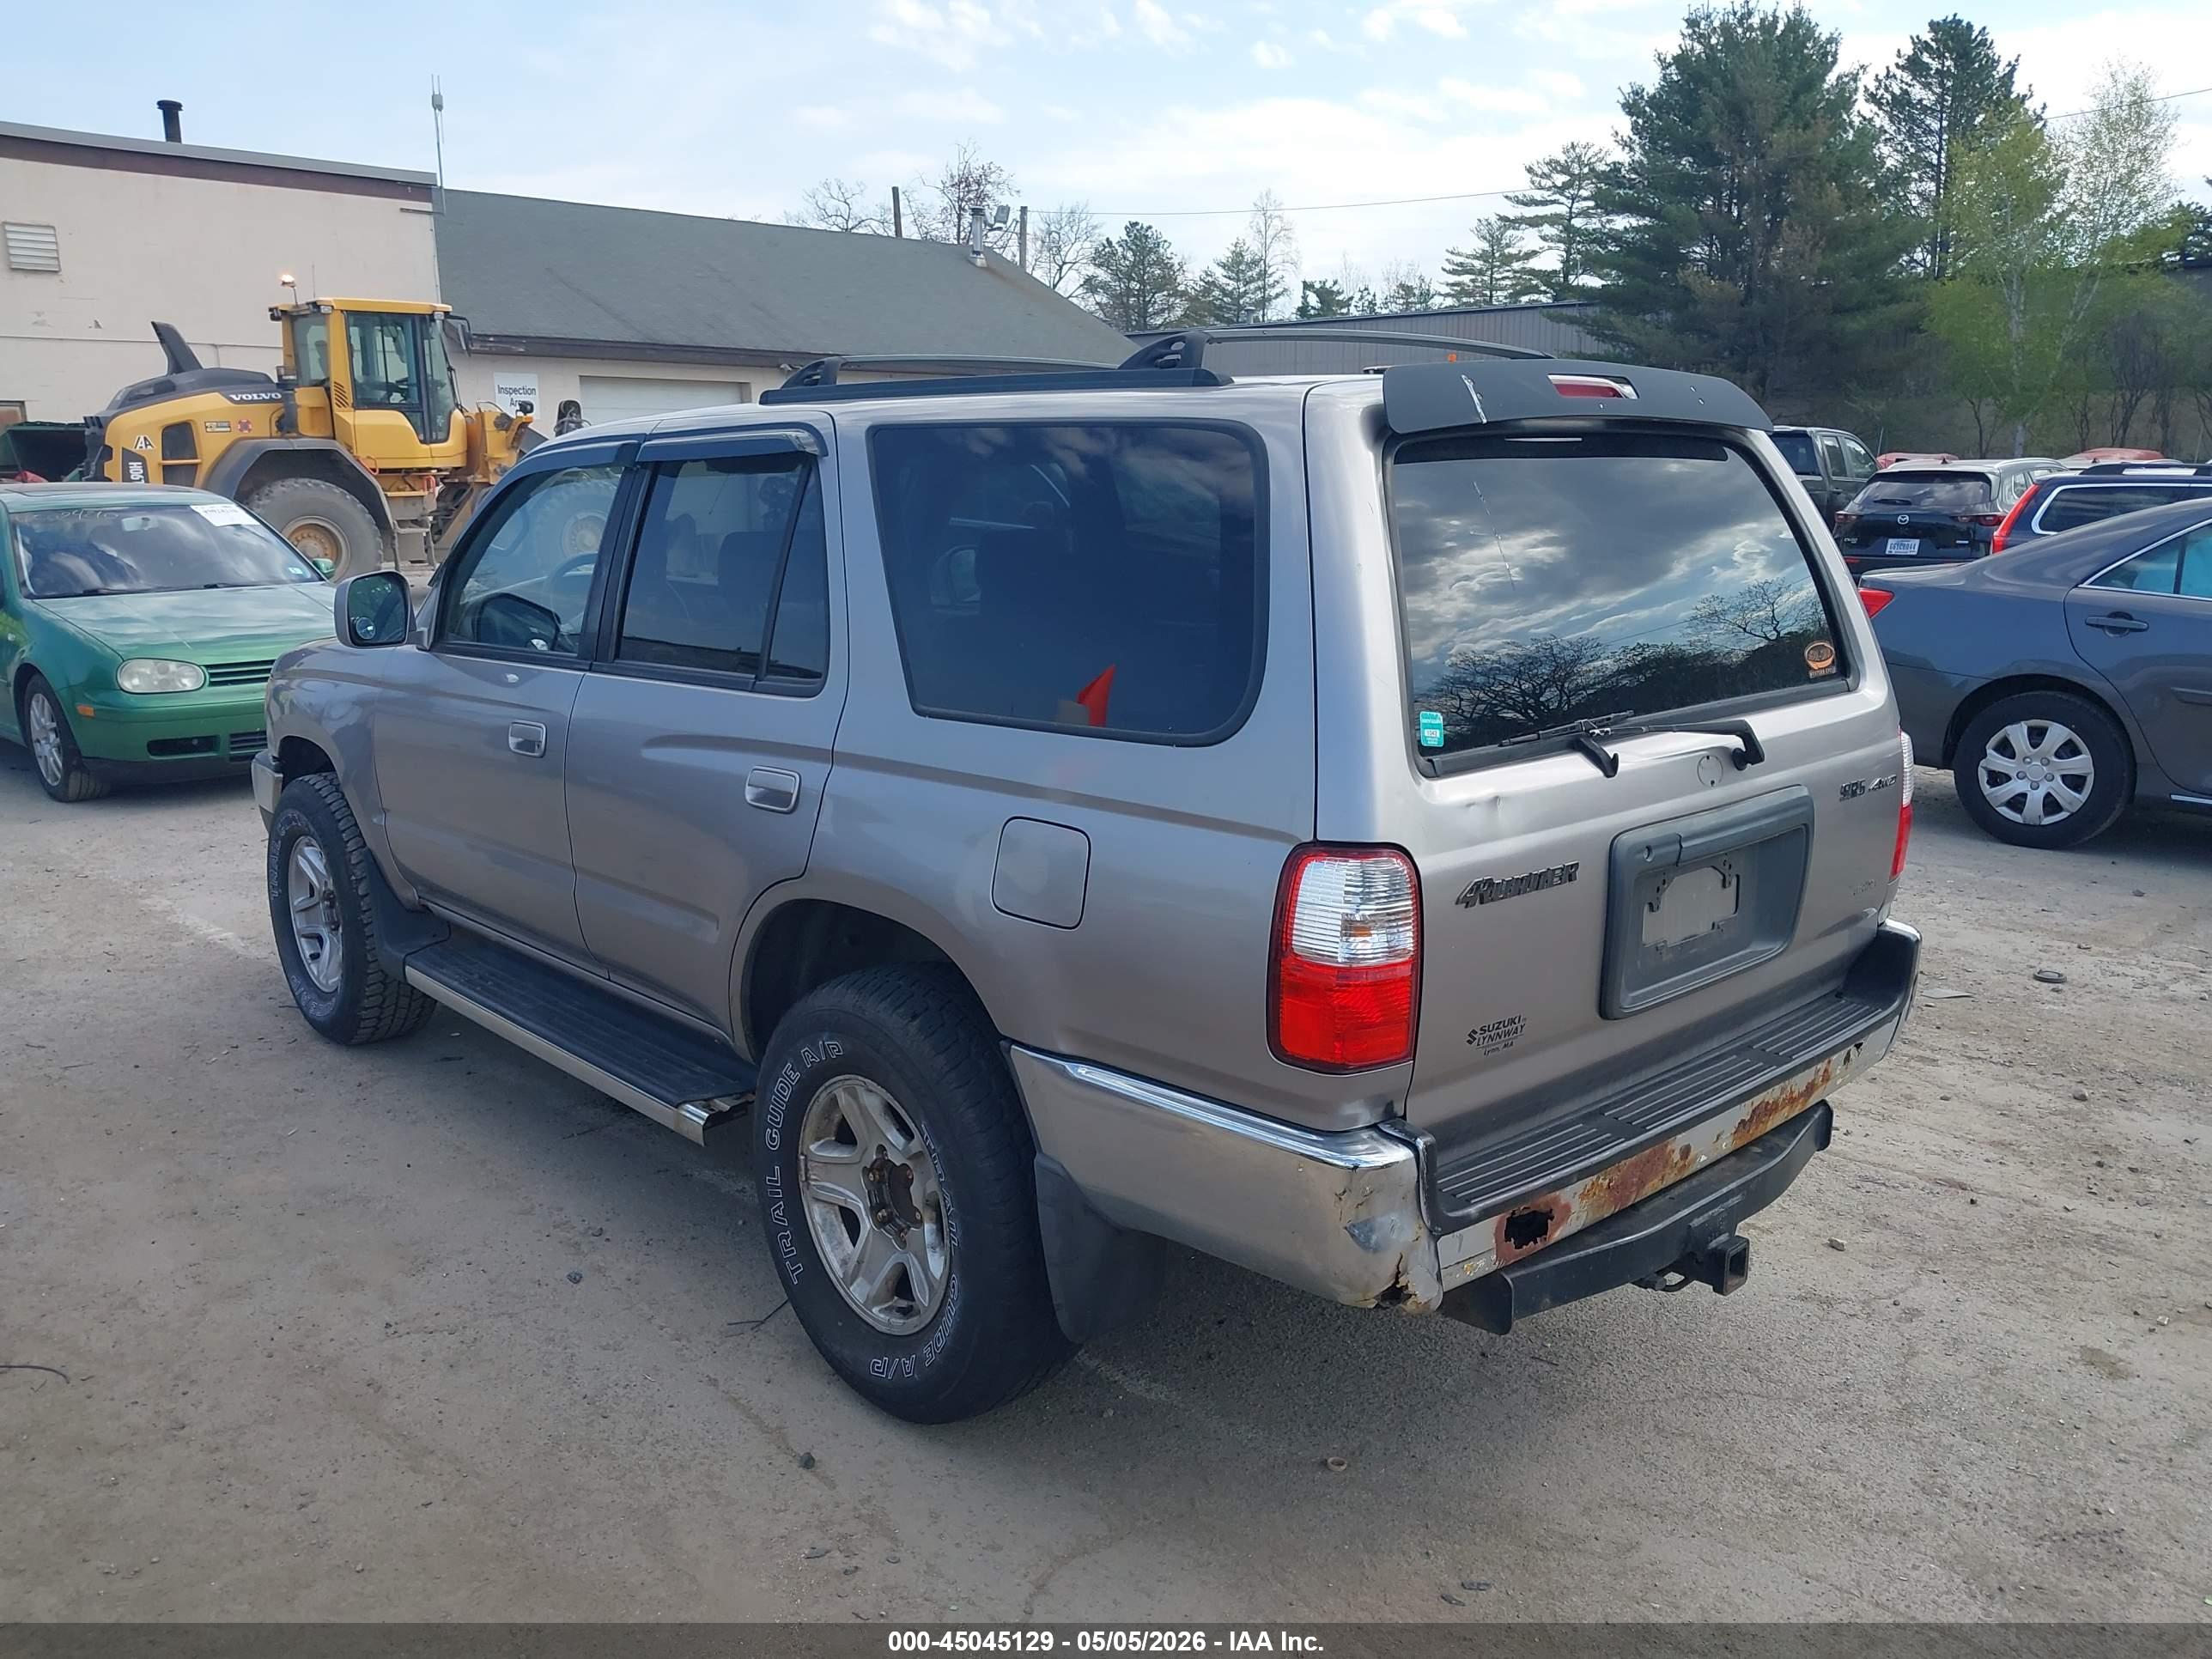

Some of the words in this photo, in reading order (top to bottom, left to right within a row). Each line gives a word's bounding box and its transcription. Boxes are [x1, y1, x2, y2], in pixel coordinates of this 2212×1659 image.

[229, 392, 283, 401] VOLVO
[497, 385, 537, 397] Inspection
[1476, 1023, 1526, 1047] LYNNWAY
[1479, 1014, 1522, 1036] SUZUKI
[801, 1040, 843, 1068] A/P
[765, 1063, 800, 1151] GUIDE
[766, 1165, 804, 1285] TRAIL
[923, 1273, 958, 1367] GUIDE
[869, 1354, 916, 1380] A/P
